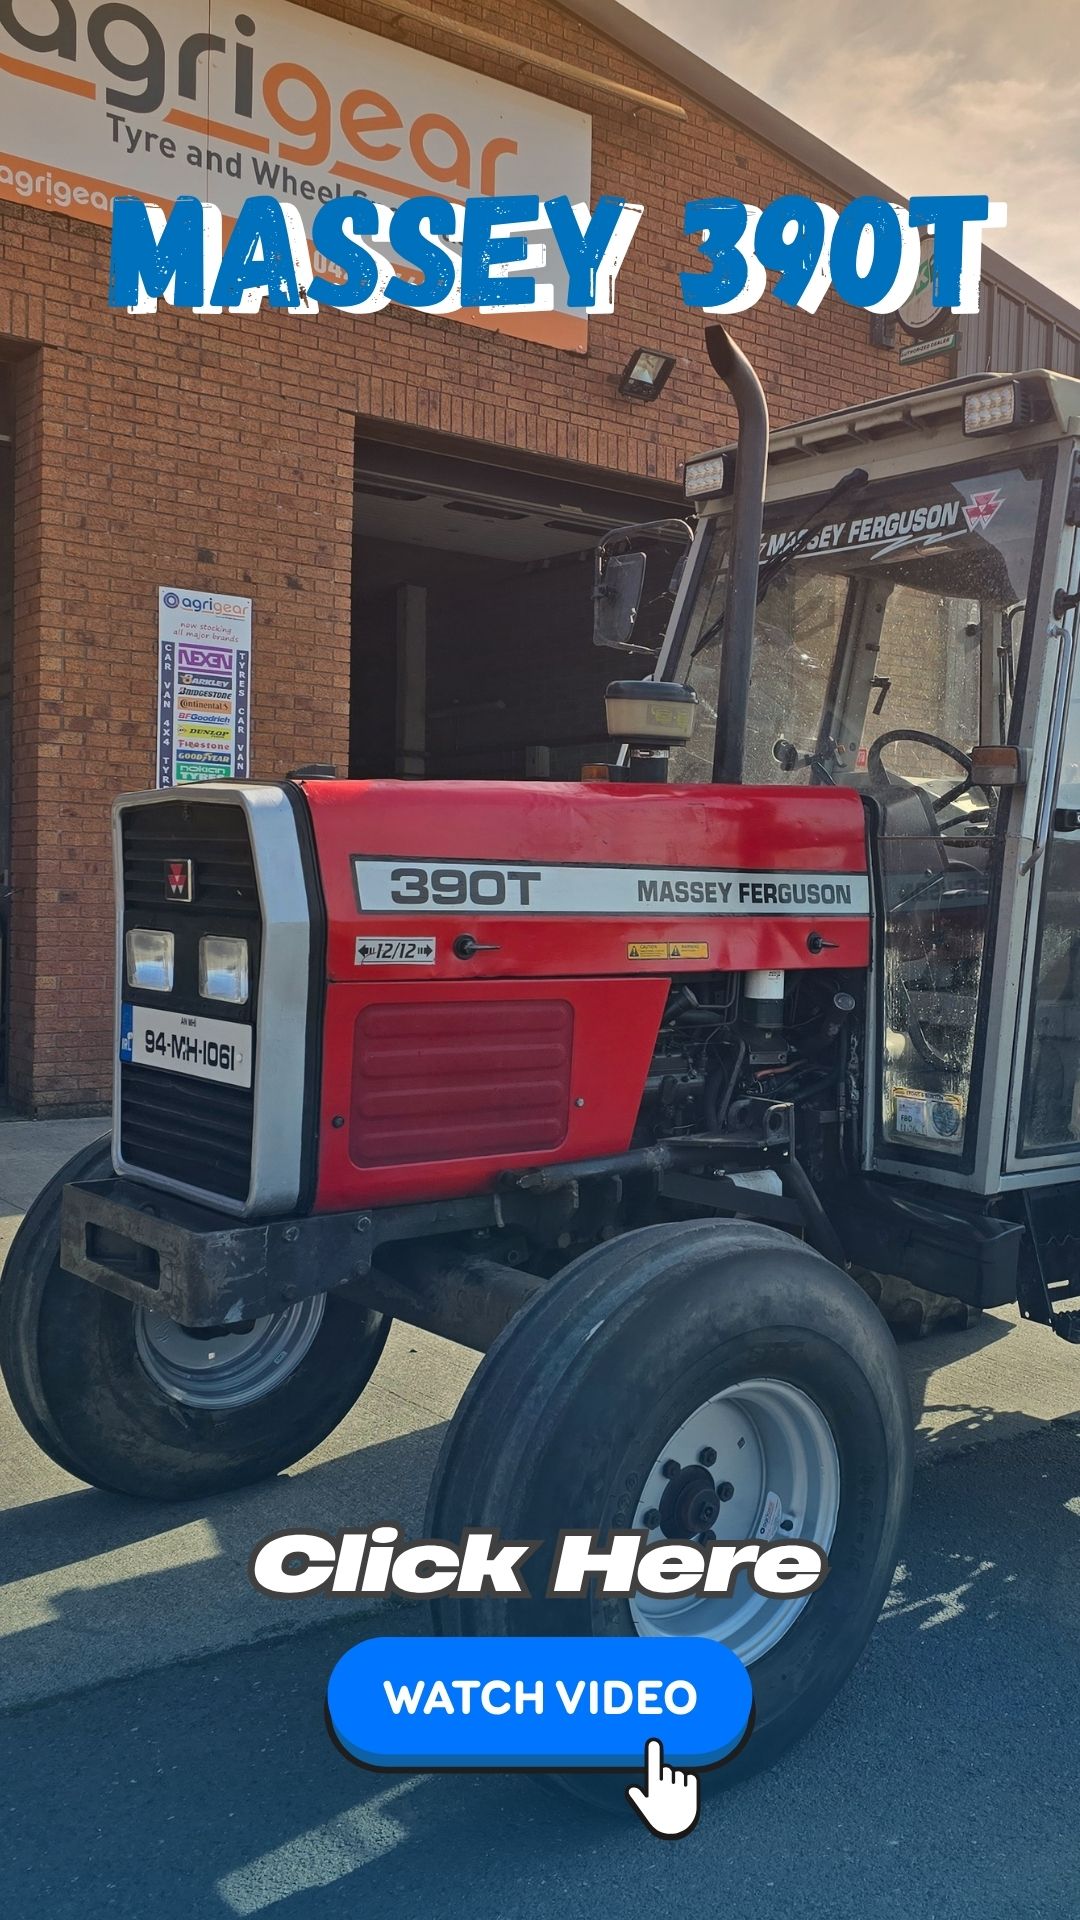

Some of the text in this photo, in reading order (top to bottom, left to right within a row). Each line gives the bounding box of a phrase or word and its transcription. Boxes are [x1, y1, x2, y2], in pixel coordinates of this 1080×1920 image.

[0, 0, 518, 196] agrigear
[106, 112, 176, 153] Tyre
[187, 145, 241, 179] and
[848, 501, 959, 543] FERGUSON
[182, 597, 248, 615] agrigear
[173, 629, 239, 643] all major brands
[200, 624, 232, 635] stocking
[164, 644, 172, 671] CAR
[178, 649, 232, 670] NEXEN
[238, 652, 246, 697] TYRES
[163, 681, 171, 708] VAN
[178, 687, 232, 700] BRIDGESTONE
[180, 699, 223, 709] Continental
[178, 712, 230, 724] BFGoodrich
[189, 728, 229, 737] DUNLOP
[178, 752, 230, 763] GOODYEAR
[162, 757, 170, 788] TYR
[180, 765, 225, 774] nokian
[391, 868, 851, 906] 390T MASSEY FERGUSON
[376, 943, 415, 959] 12/12
[145, 1029, 235, 1071] 94-MH-1061
